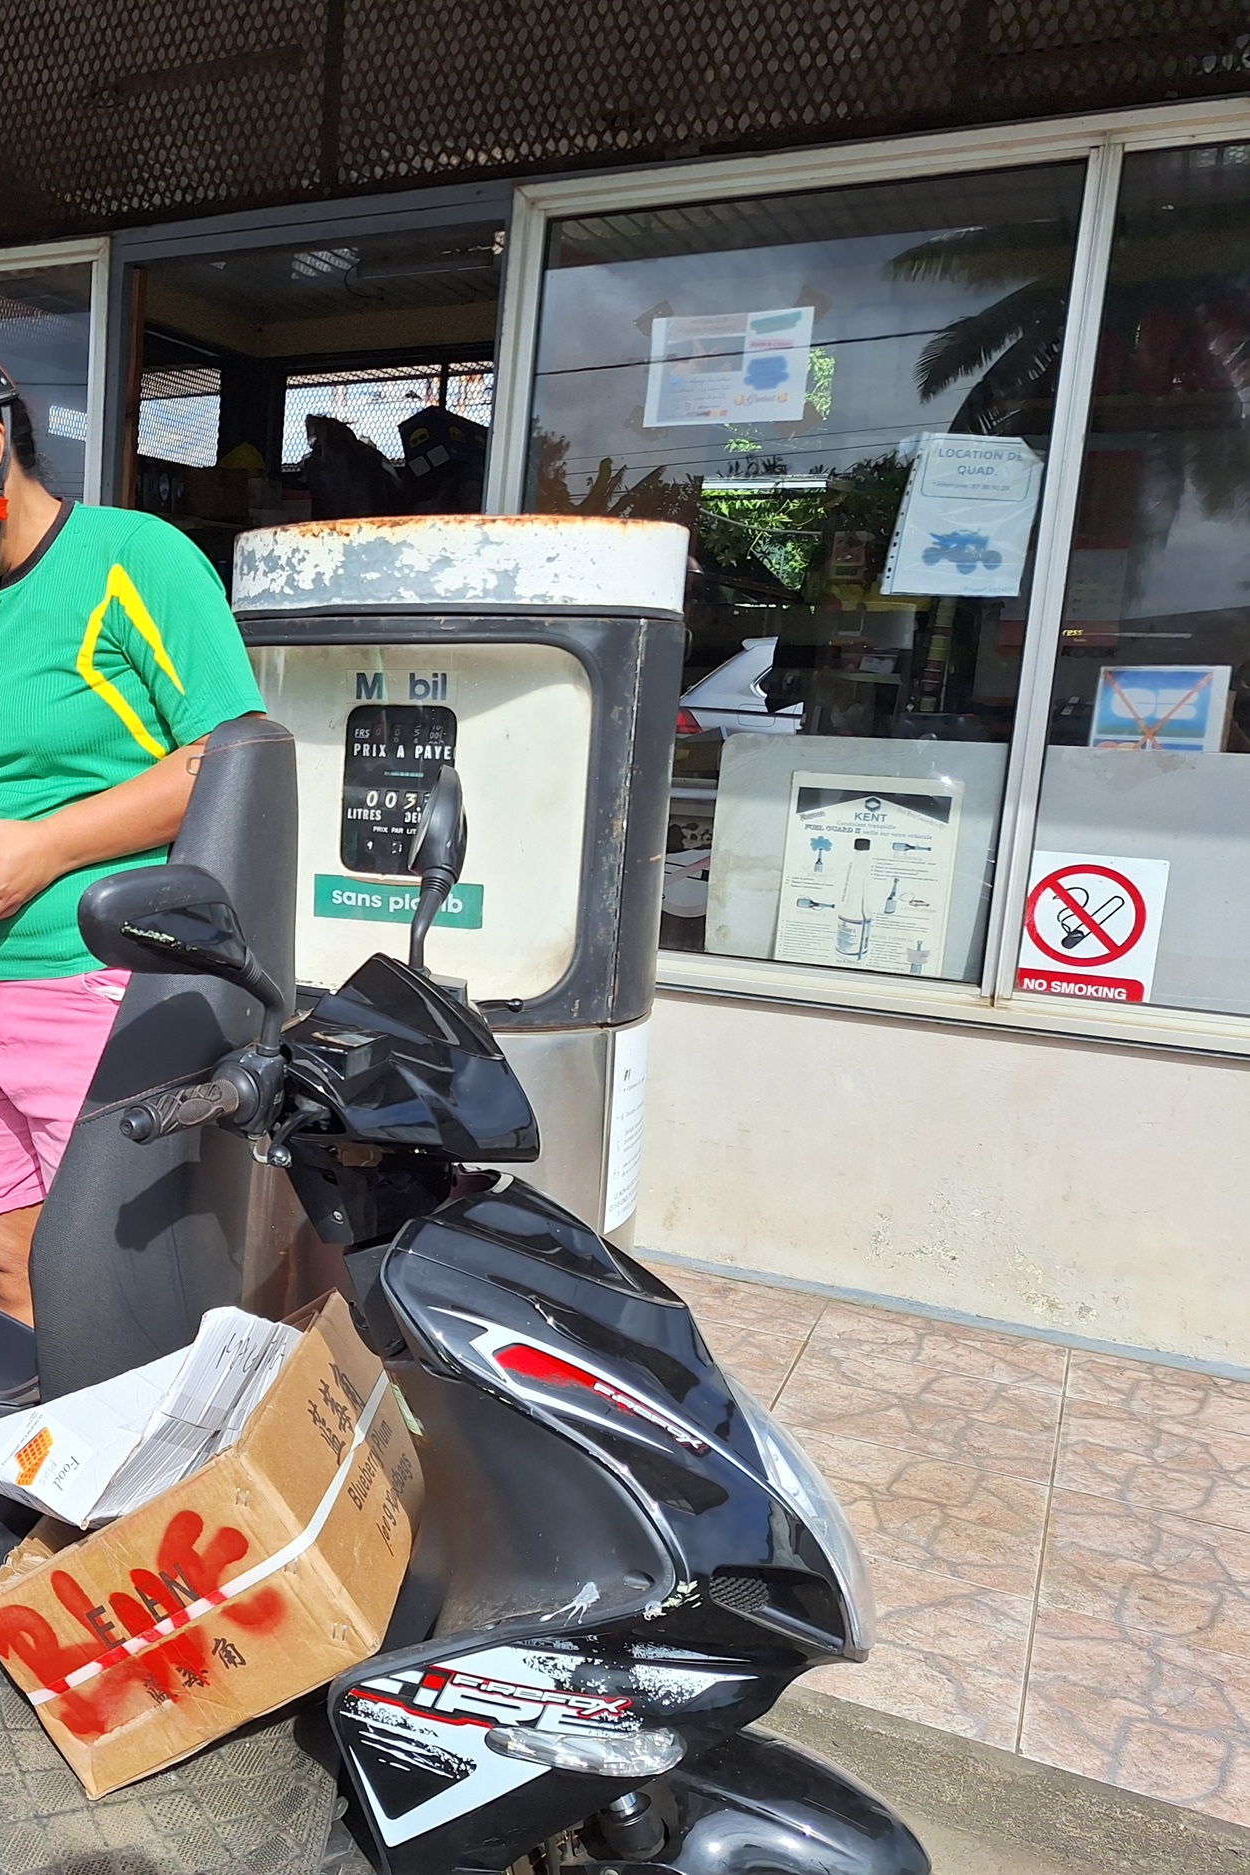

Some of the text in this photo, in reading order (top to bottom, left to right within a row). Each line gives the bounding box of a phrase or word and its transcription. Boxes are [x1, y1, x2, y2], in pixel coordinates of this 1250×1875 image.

[938, 448, 1003, 460] LOCATION
[353, 743, 386, 758] PRIX
[397, 745, 405, 759] A
[347, 808, 382, 822] LITRES
[854, 812, 888, 823] KENT
[372, 826, 388, 834] PRIX
[391, 827, 403, 835] PAR
[804, 823, 824, 831] FUEL
[826, 825, 854, 834] GUARD
[332, 890, 463, 914] sans plob
[1023, 978, 1128, 1001] NO SMOKING
[53, 1456, 80, 1491] Food
[347, 1420, 393, 1512] Blueberry Plum
